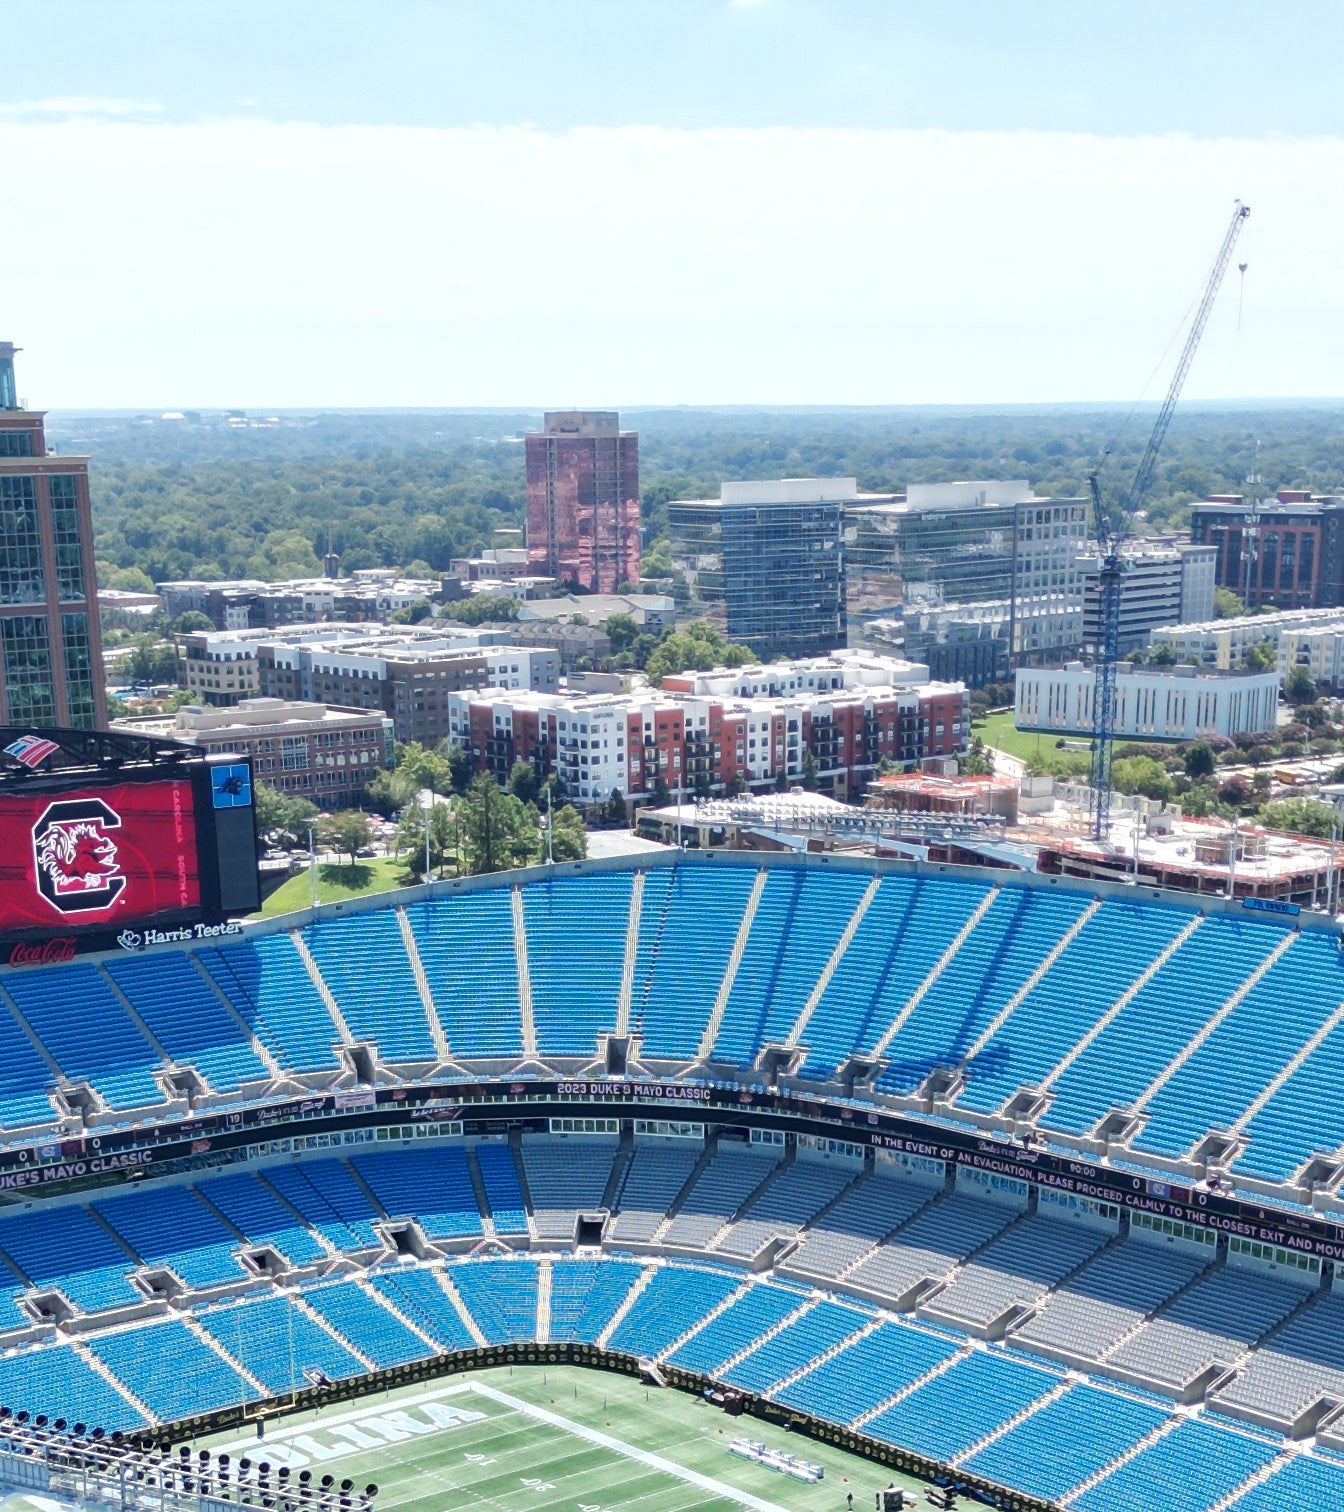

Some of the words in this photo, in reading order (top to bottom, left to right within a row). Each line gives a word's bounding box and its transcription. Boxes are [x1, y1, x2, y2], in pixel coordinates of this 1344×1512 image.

[143, 926, 193, 945] Harris
[194, 922, 242, 939] Teeter
[557, 1083, 587, 1094] 2023
[634, 1085, 662, 1096] MAYO
[665, 1087, 711, 1100] CLASSIC
[229, 1114, 240, 1123] 19
[43, 1160, 87, 1182] MAYO
[90, 1150, 153, 1174] CLASSIC
[871, 1134, 882, 1145] IN
[884, 1136, 903, 1149] THE
[905, 1141, 937, 1156] EVENT
[940, 1148, 955, 1159] OF
[957, 1152, 972, 1164] AN
[973, 1155, 1036, 1182] EVACUATION,
[1037, 1173, 1074, 1190] PLEASE
[1076, 1181, 1123, 1202] PROCEED
[1125, 1194, 1166, 1213] CALMLY
[1169, 1204, 1183, 1217] TO
[1185, 1208, 1207, 1224] THE
[1208, 1215, 1258, 1237] CLOSEST
[1259, 1228, 1285, 1244] EXIT
[1287, 1236, 1313, 1251] AND
[221, 1402, 489, 1473] OLINA
